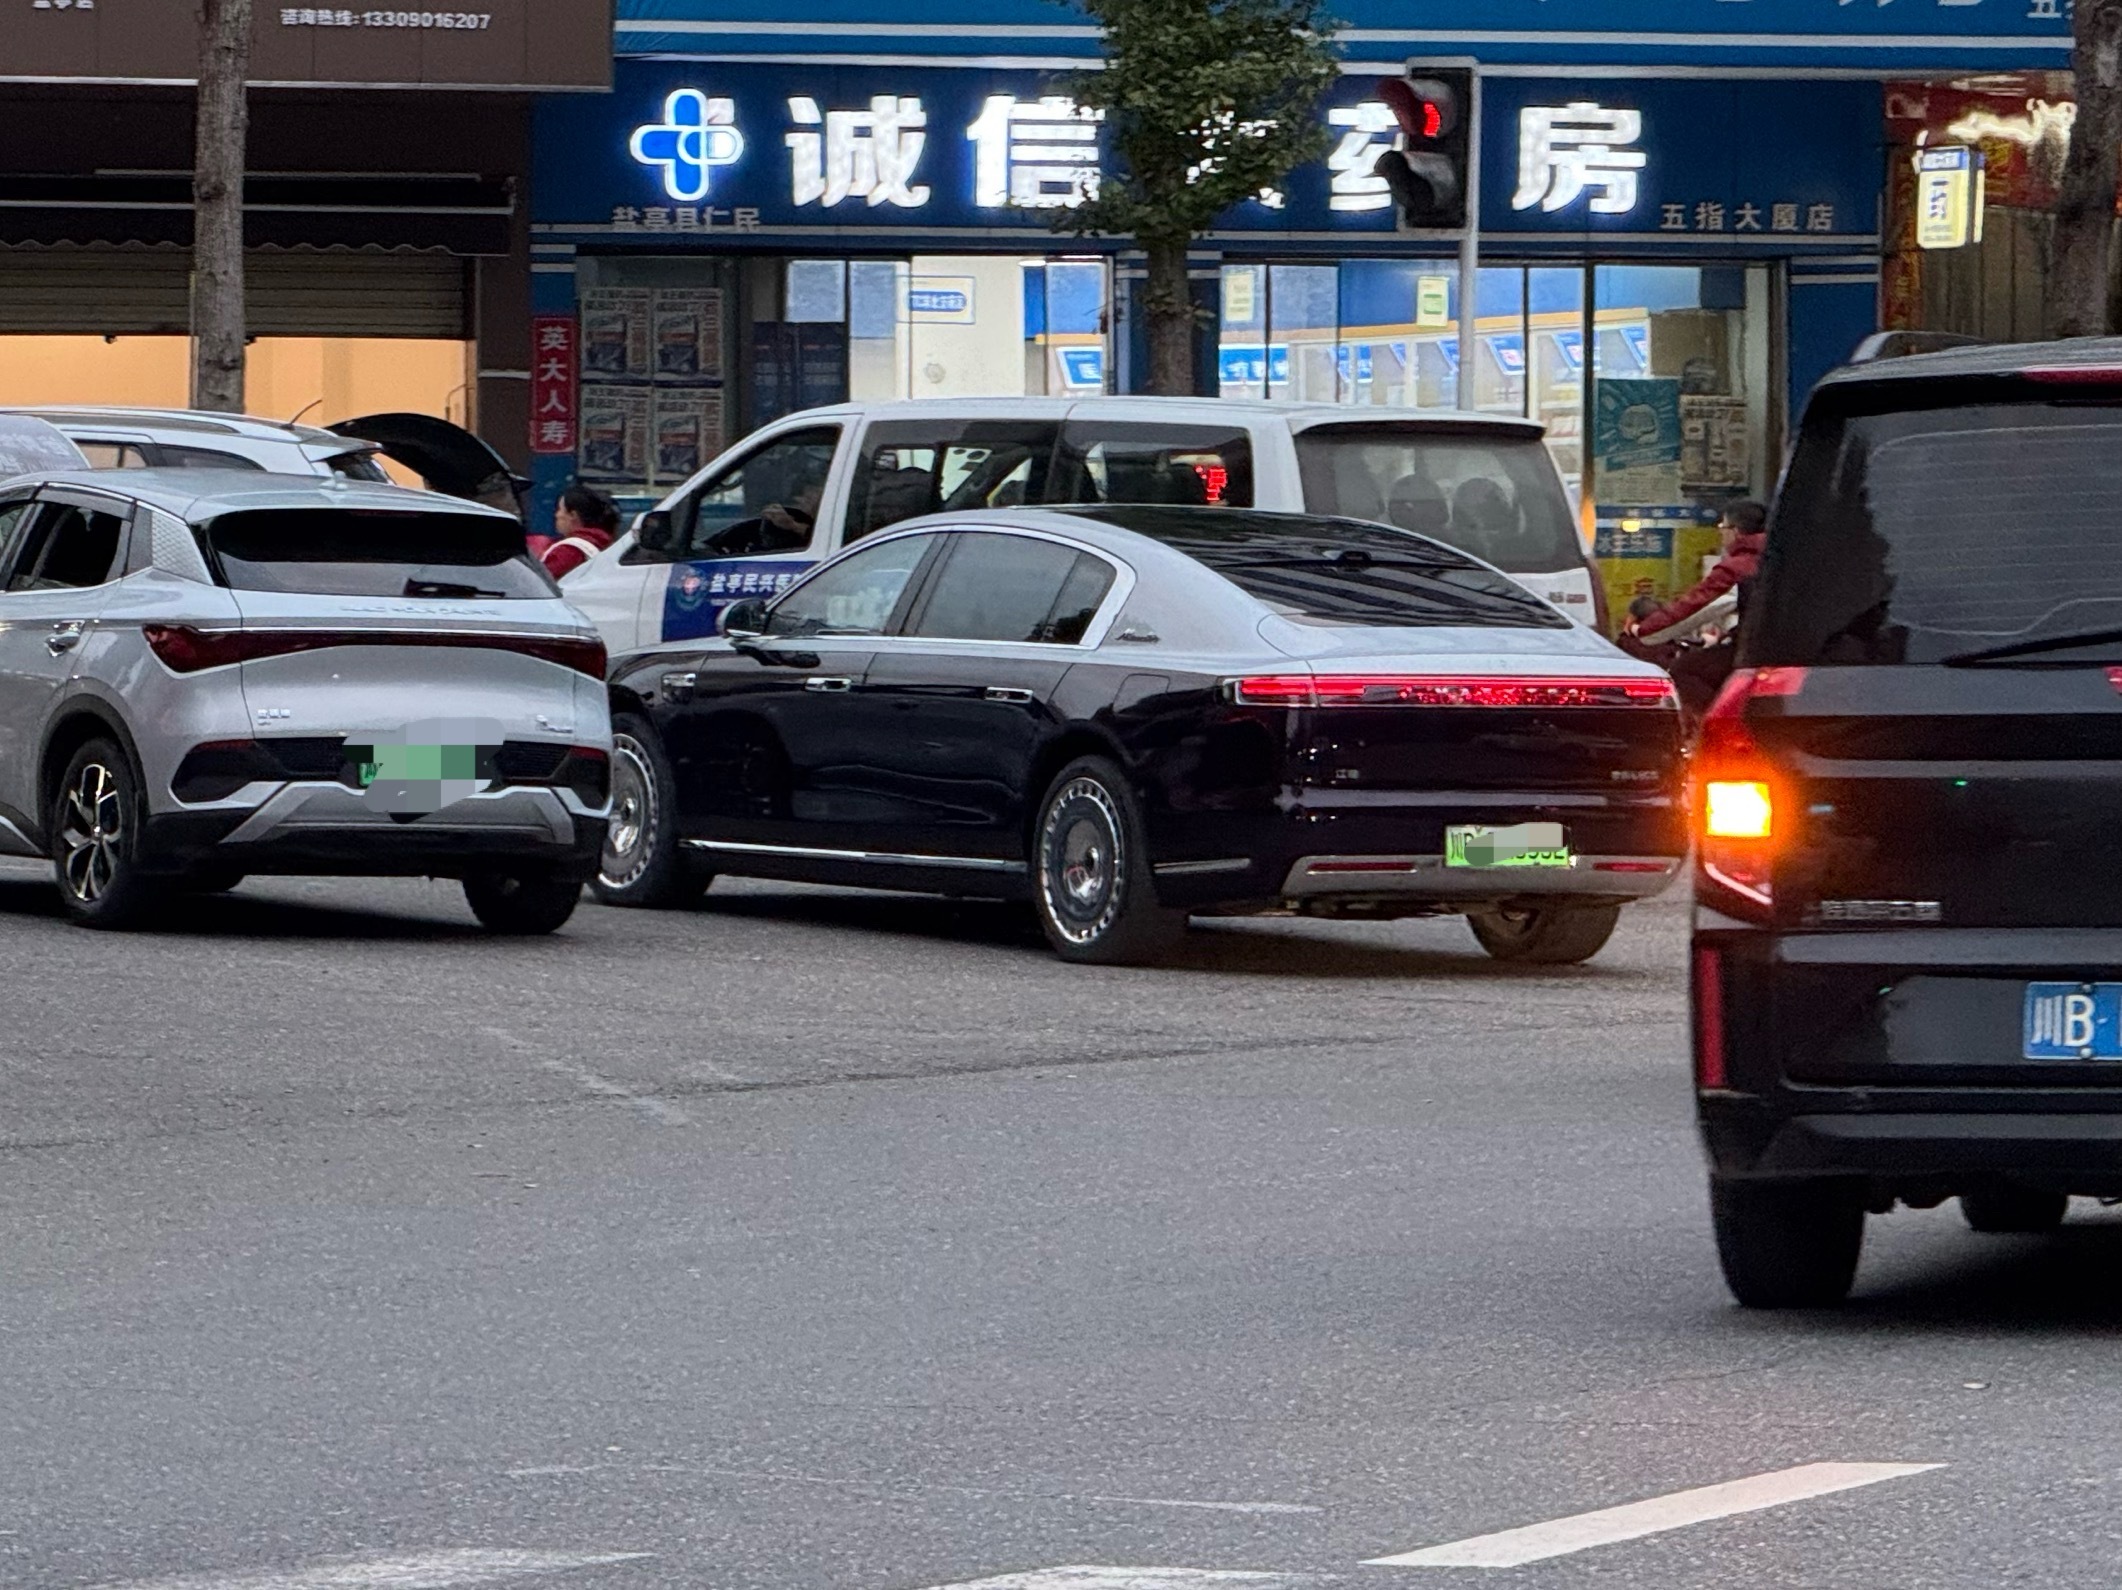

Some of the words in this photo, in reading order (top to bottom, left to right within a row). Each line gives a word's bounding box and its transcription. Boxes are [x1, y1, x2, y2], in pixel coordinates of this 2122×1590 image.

[785, 93, 1647, 214] 诚信药房
[540, 325, 568, 444] 英大人寿
